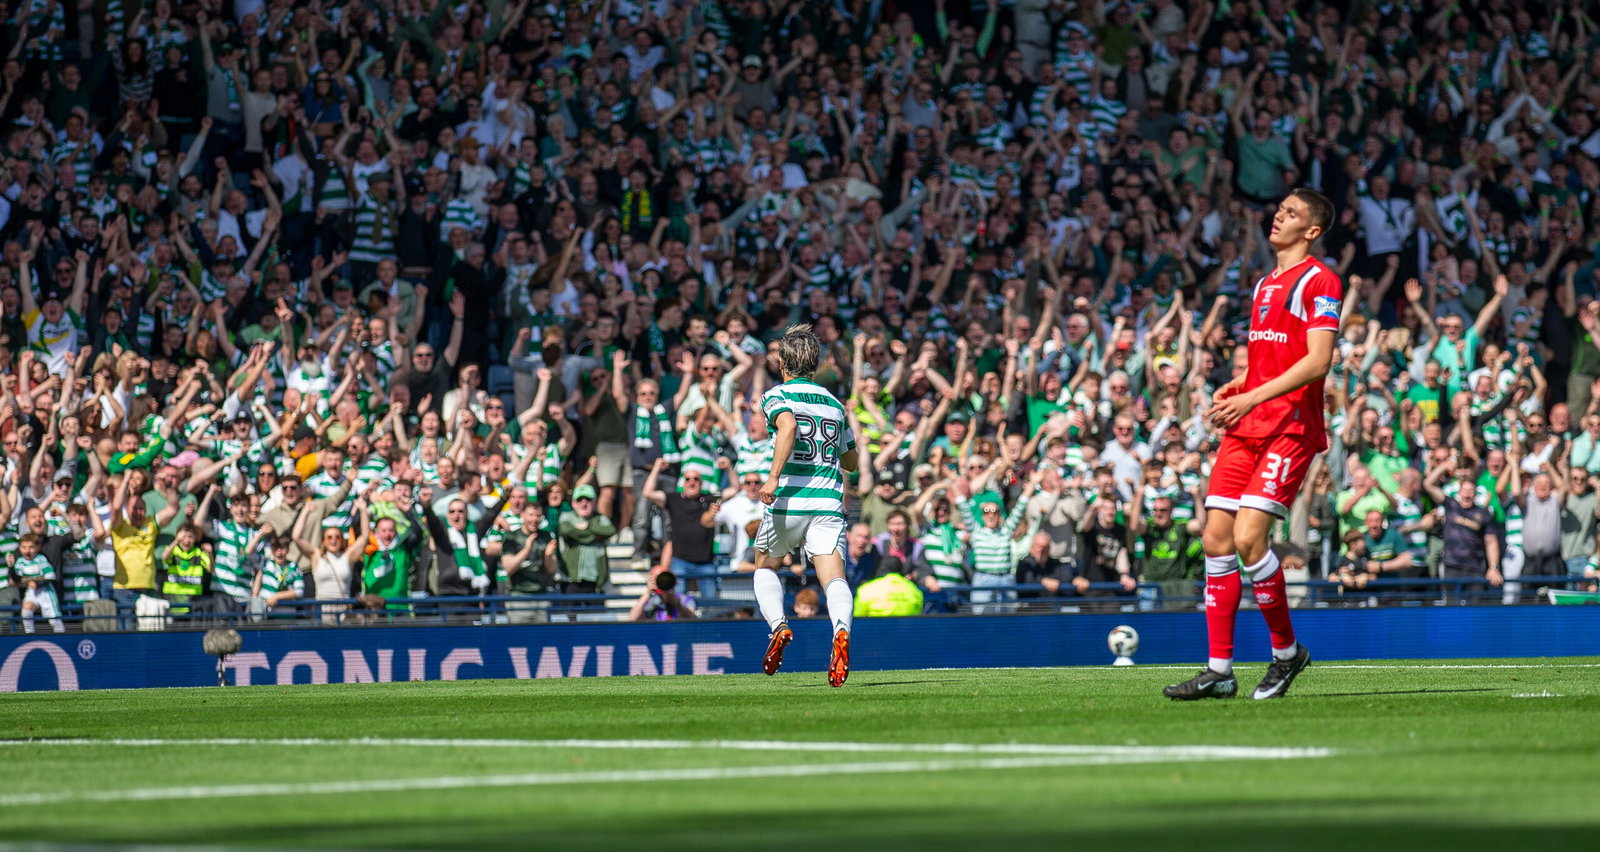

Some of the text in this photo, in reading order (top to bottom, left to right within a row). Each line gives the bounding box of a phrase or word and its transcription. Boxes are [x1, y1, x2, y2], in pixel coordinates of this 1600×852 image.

[798, 393, 830, 405] DAIZEN
[793, 413, 839, 464] 38
[1261, 452, 1292, 483] 31
[216, 642, 734, 686] TONIC WINE
